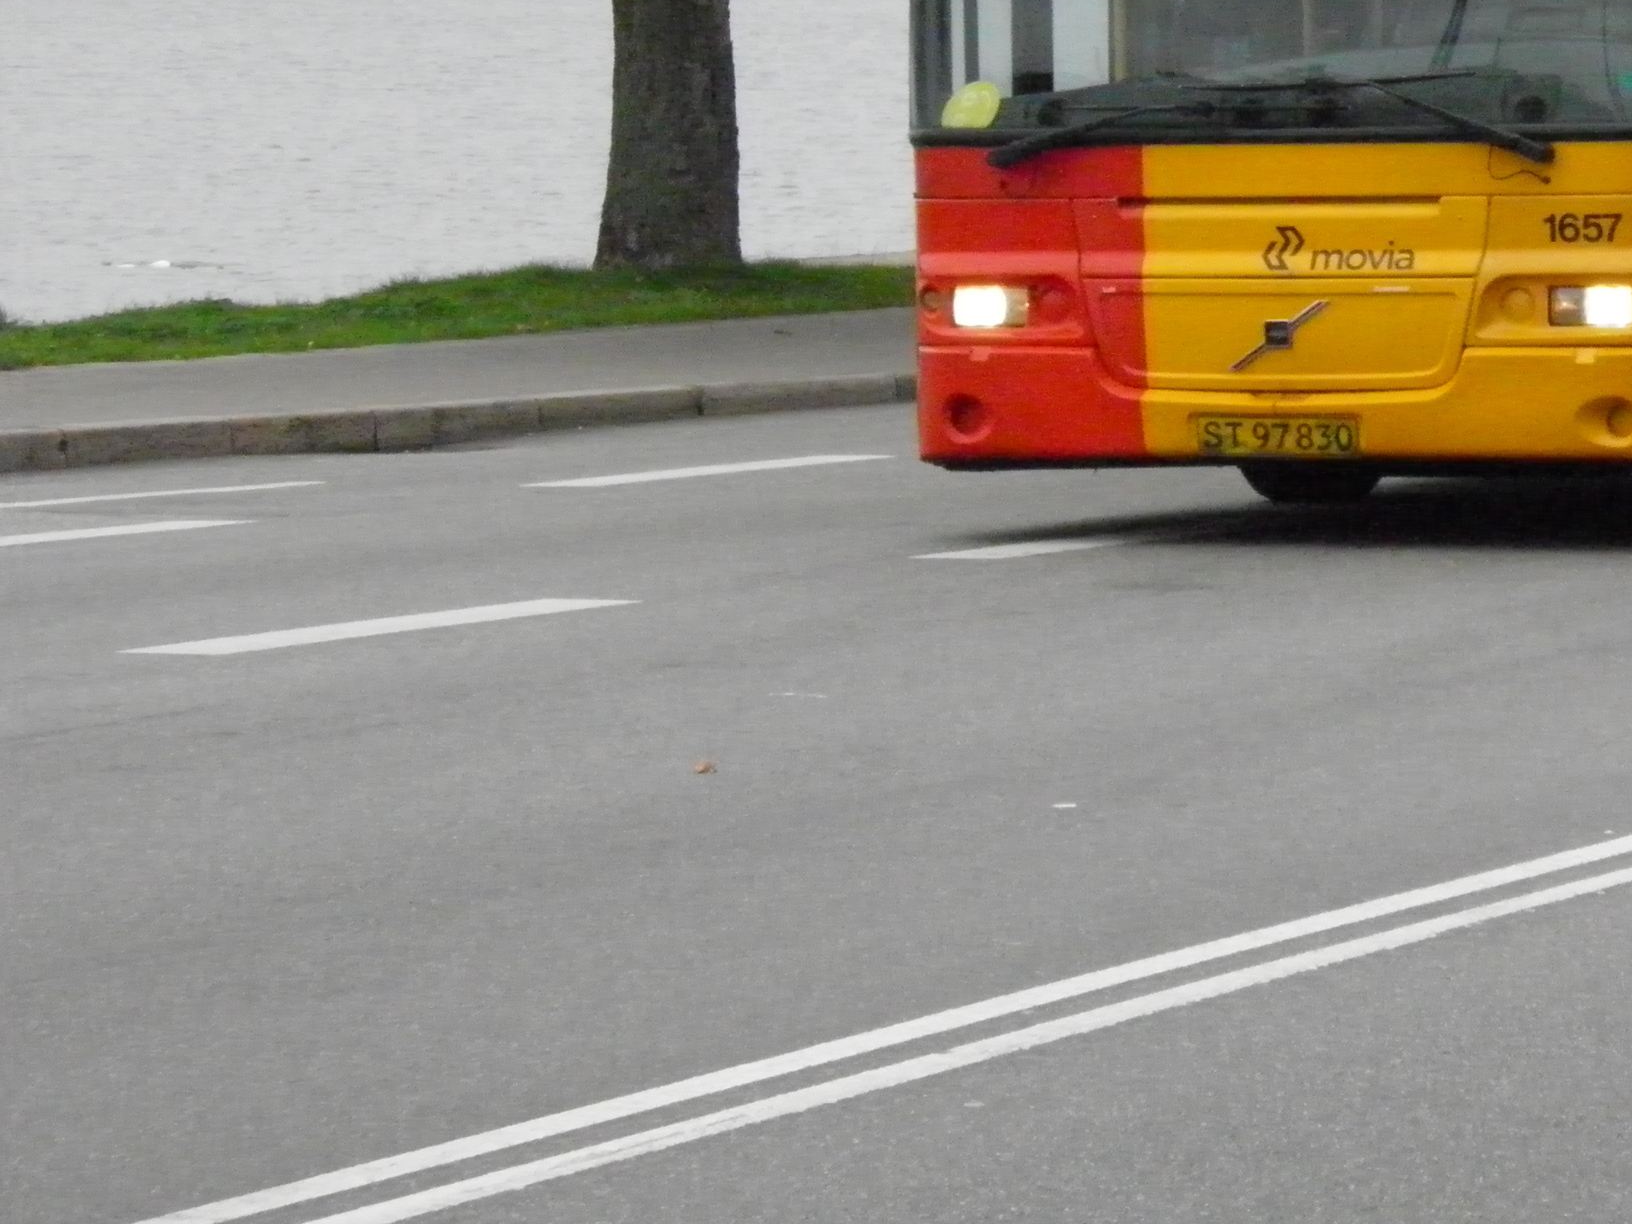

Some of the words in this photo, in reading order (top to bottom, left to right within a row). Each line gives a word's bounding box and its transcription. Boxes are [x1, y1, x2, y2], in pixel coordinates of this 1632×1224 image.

[1543, 213, 1622, 243] 1657
[1310, 240, 1416, 271] movia
[1203, 421, 1244, 449] ST
[1252, 423, 1354, 452] 97830
